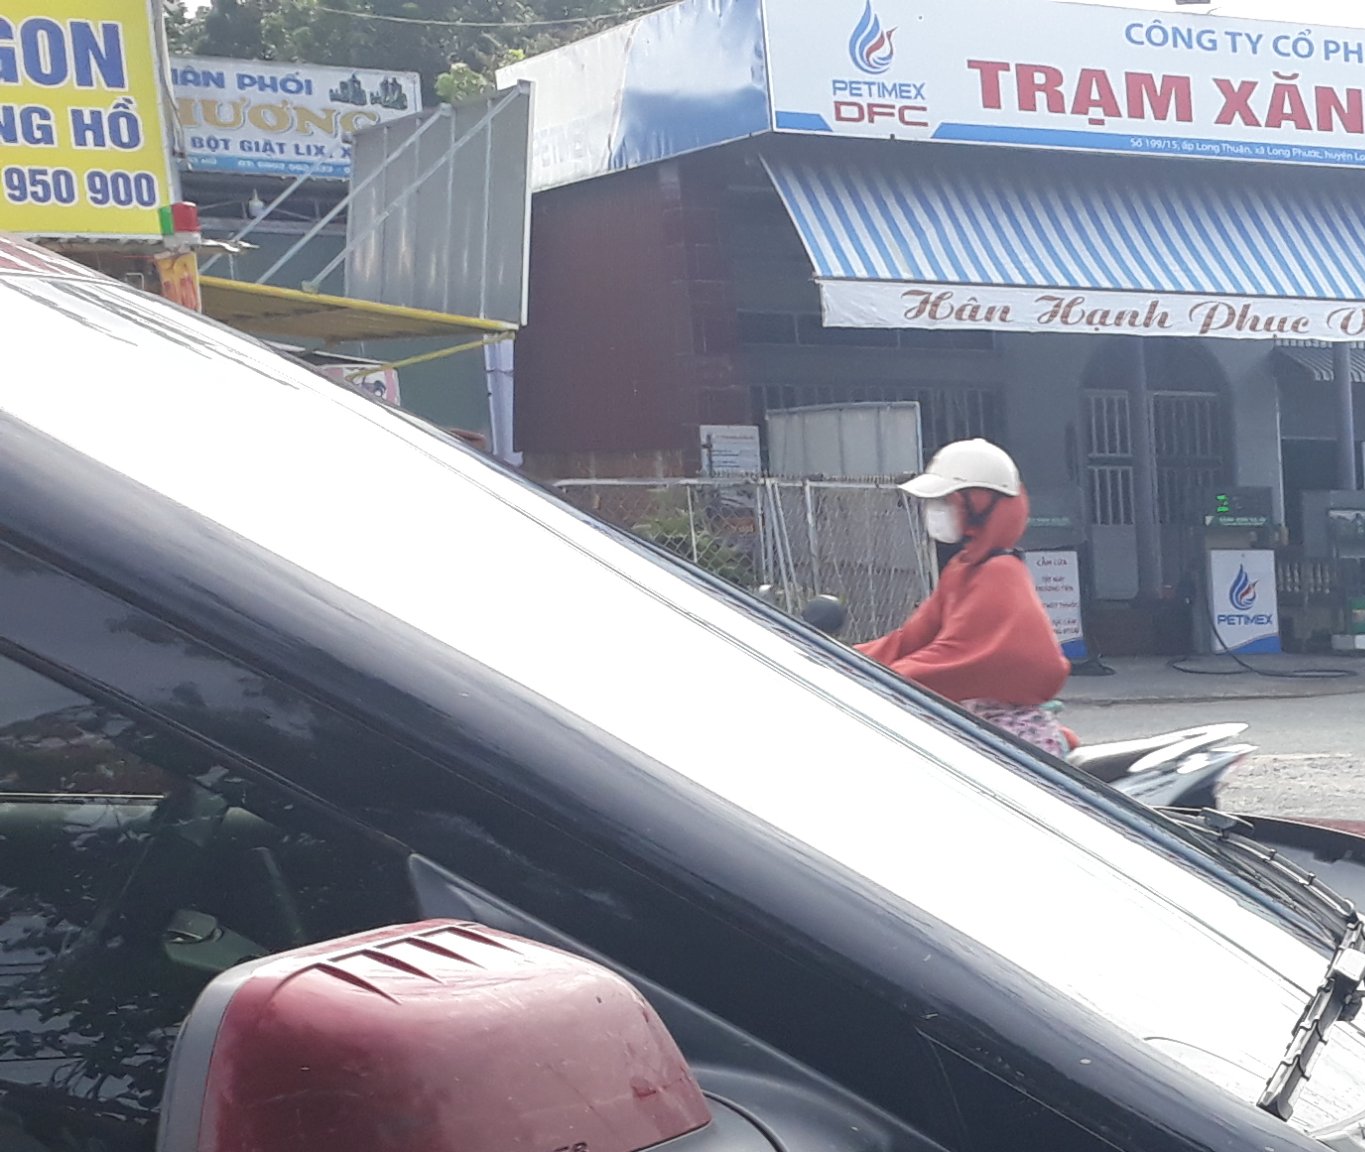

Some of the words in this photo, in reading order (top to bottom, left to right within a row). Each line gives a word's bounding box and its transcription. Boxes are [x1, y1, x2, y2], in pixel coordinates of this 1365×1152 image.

[1124, 19, 1219, 52] CÔNG
[1224, 31, 1264, 55] TY
[1271, 28, 1315, 59] CỔ
[831, 79, 928, 101] PETIMEX
[966, 58, 1195, 126] TRẠM
[70, 96, 141, 150] HỒ
[833, 100, 930, 128] DFC
[1197, 142, 1221, 154] Long
[1267, 146, 1290, 158] Long
[4, 166, 75, 203] 950
[87, 170, 156, 207] 900
[900, 289, 1015, 324] Hân
[1034, 294, 1174, 332] Hạnh
[1217, 614, 1273, 626] PETIMEX
